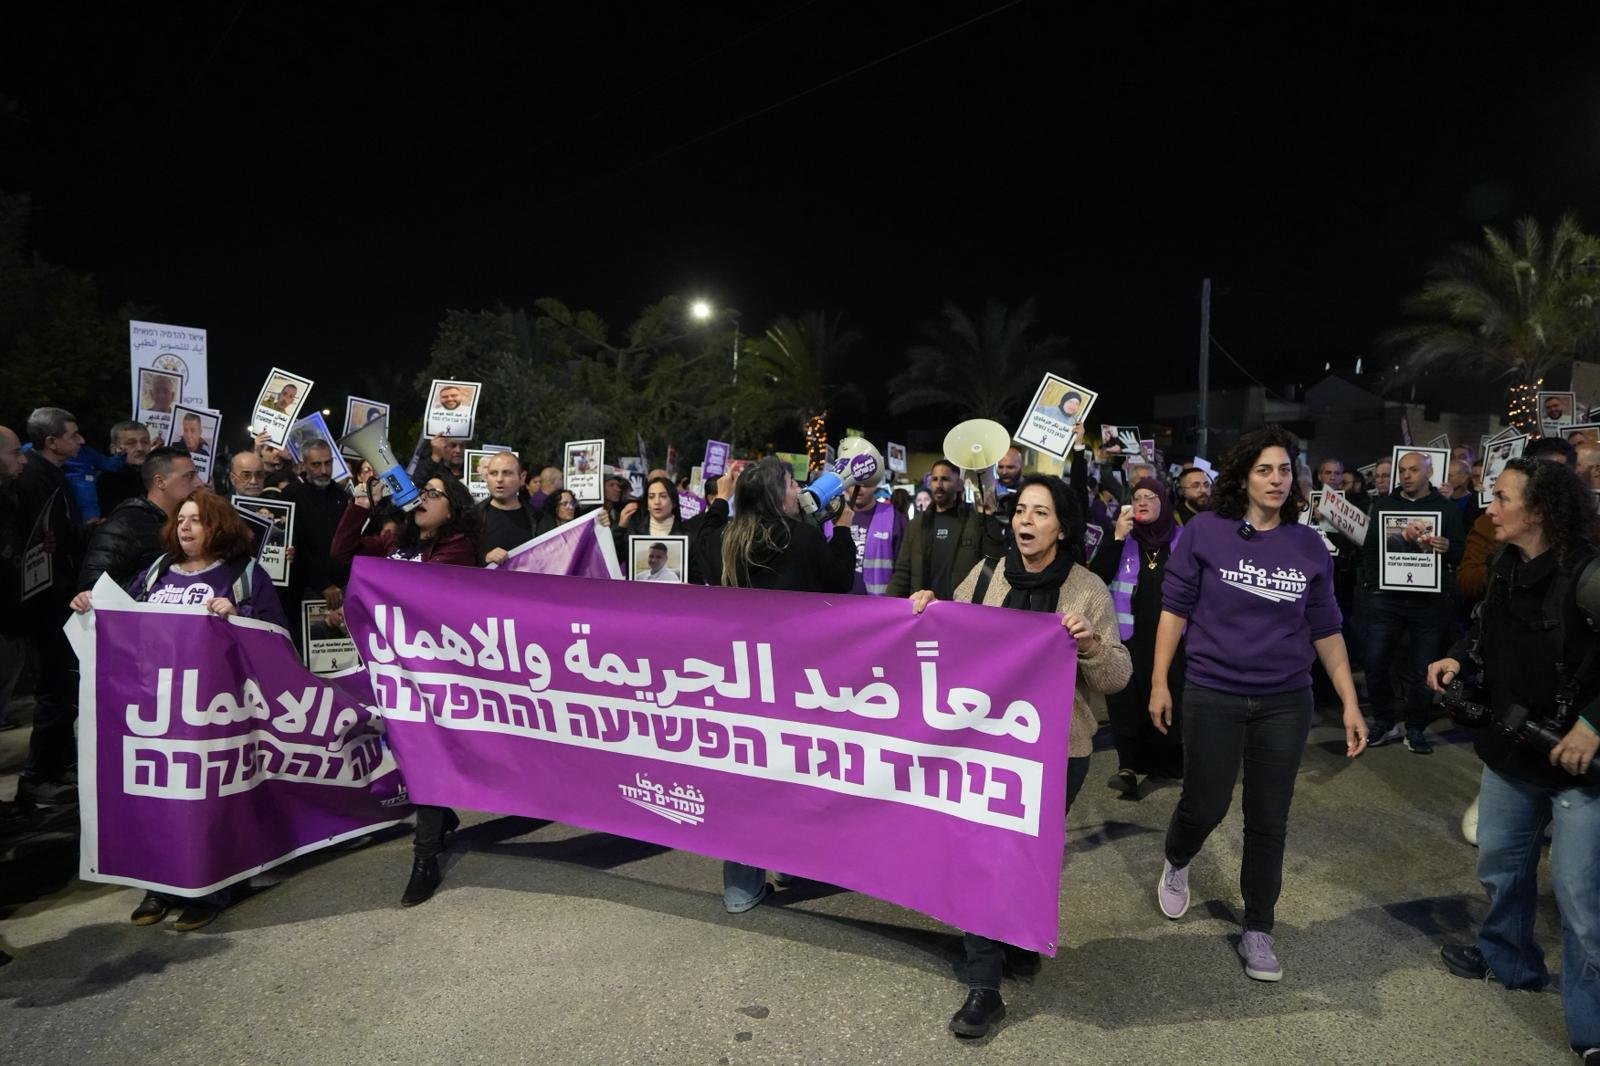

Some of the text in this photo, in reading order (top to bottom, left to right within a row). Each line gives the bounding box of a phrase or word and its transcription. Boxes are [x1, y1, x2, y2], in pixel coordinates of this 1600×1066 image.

[1219, 568, 1307, 593] עומדים ביחד
[1271, 566, 1307, 582] نقف
[368, 604, 551, 691] والاهمال
[564, 623, 775, 707] الجريمة
[125, 668, 358, 752] والاهمال
[375, 673, 557, 733] וההפקרה
[794, 667, 900, 719] ضد
[565, 702, 768, 768] הפשיעה
[780, 732, 865, 786] נגד
[618, 784, 705, 815] עומדים ביחד
[880, 749, 1026, 819] ביחד
